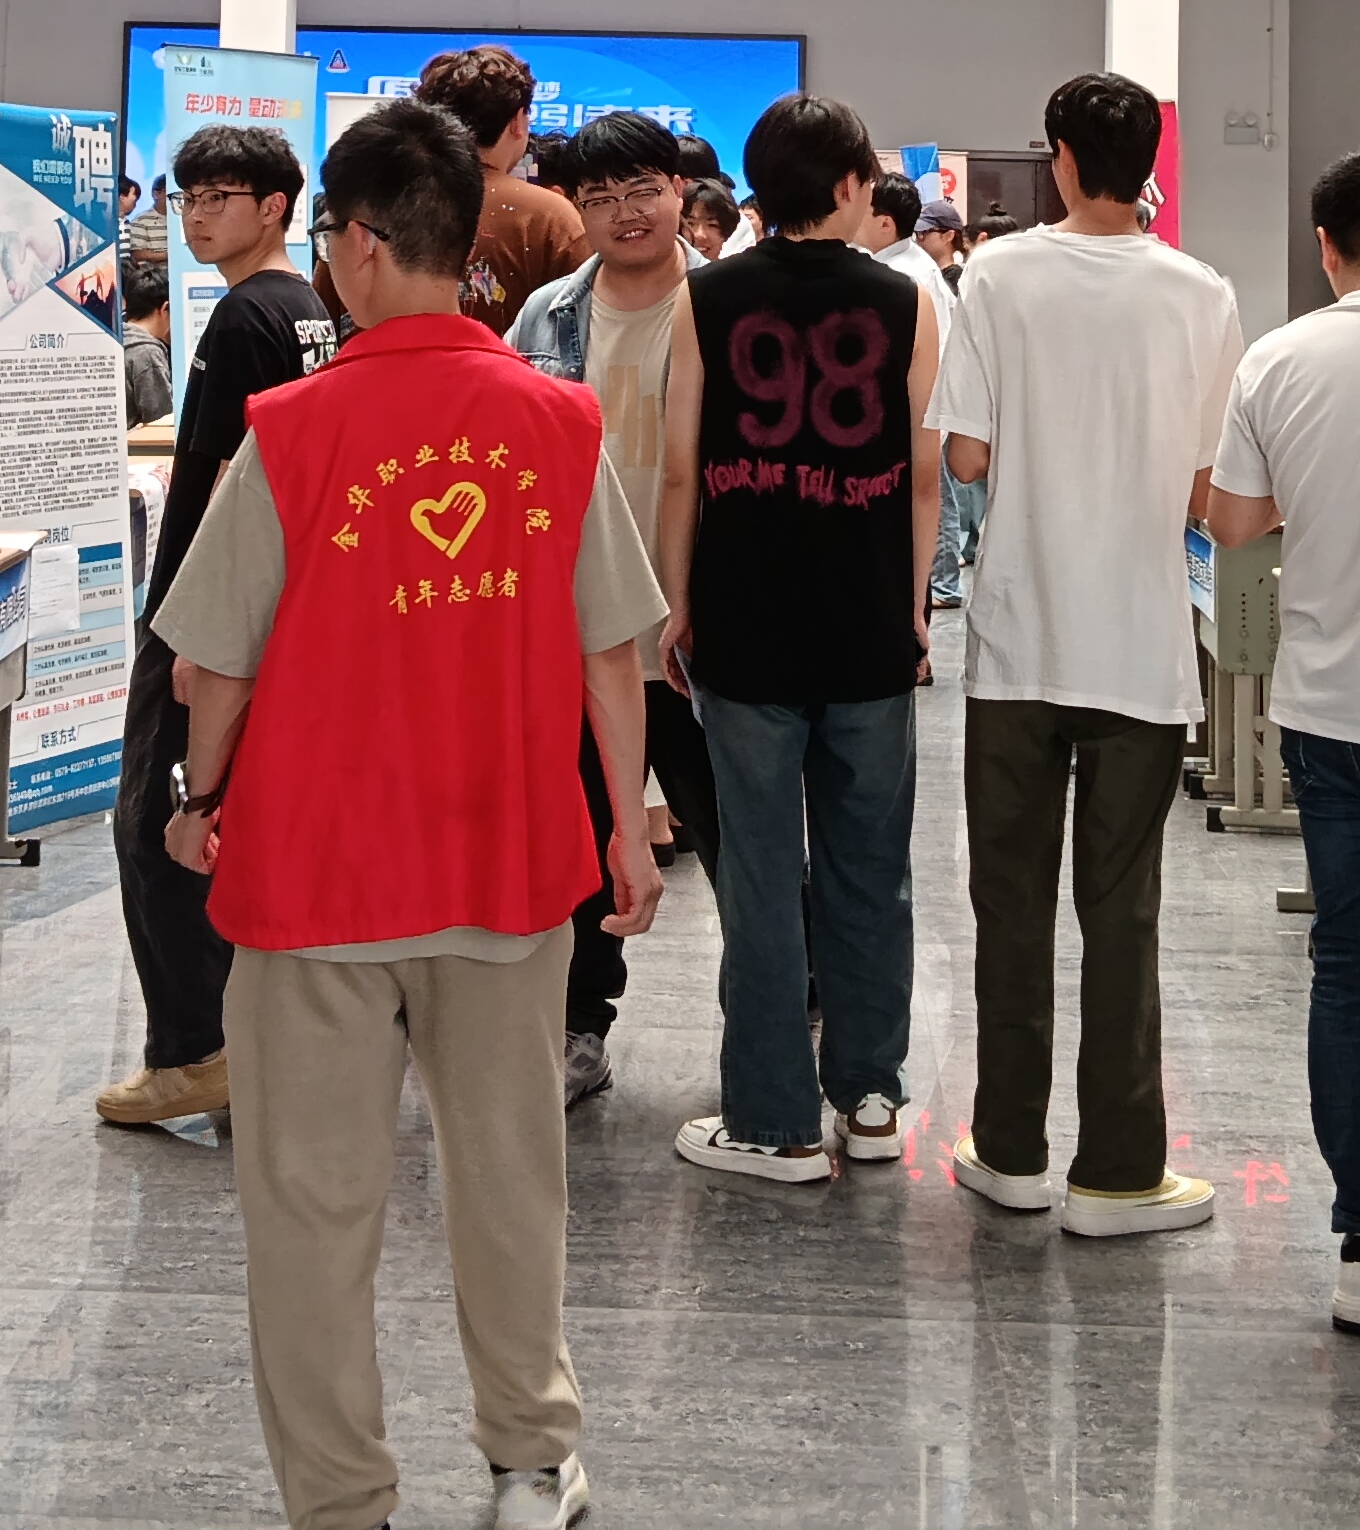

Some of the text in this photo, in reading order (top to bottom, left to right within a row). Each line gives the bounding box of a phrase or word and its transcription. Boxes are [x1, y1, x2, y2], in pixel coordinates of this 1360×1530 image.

[28, 332, 67, 350] 公司简介
[728, 308, 890, 449] 98
[330, 436, 552, 553] 金华职业技术学院
[388, 566, 520, 615] 青年志愿者
[40, 725, 77, 749] 联系方式
